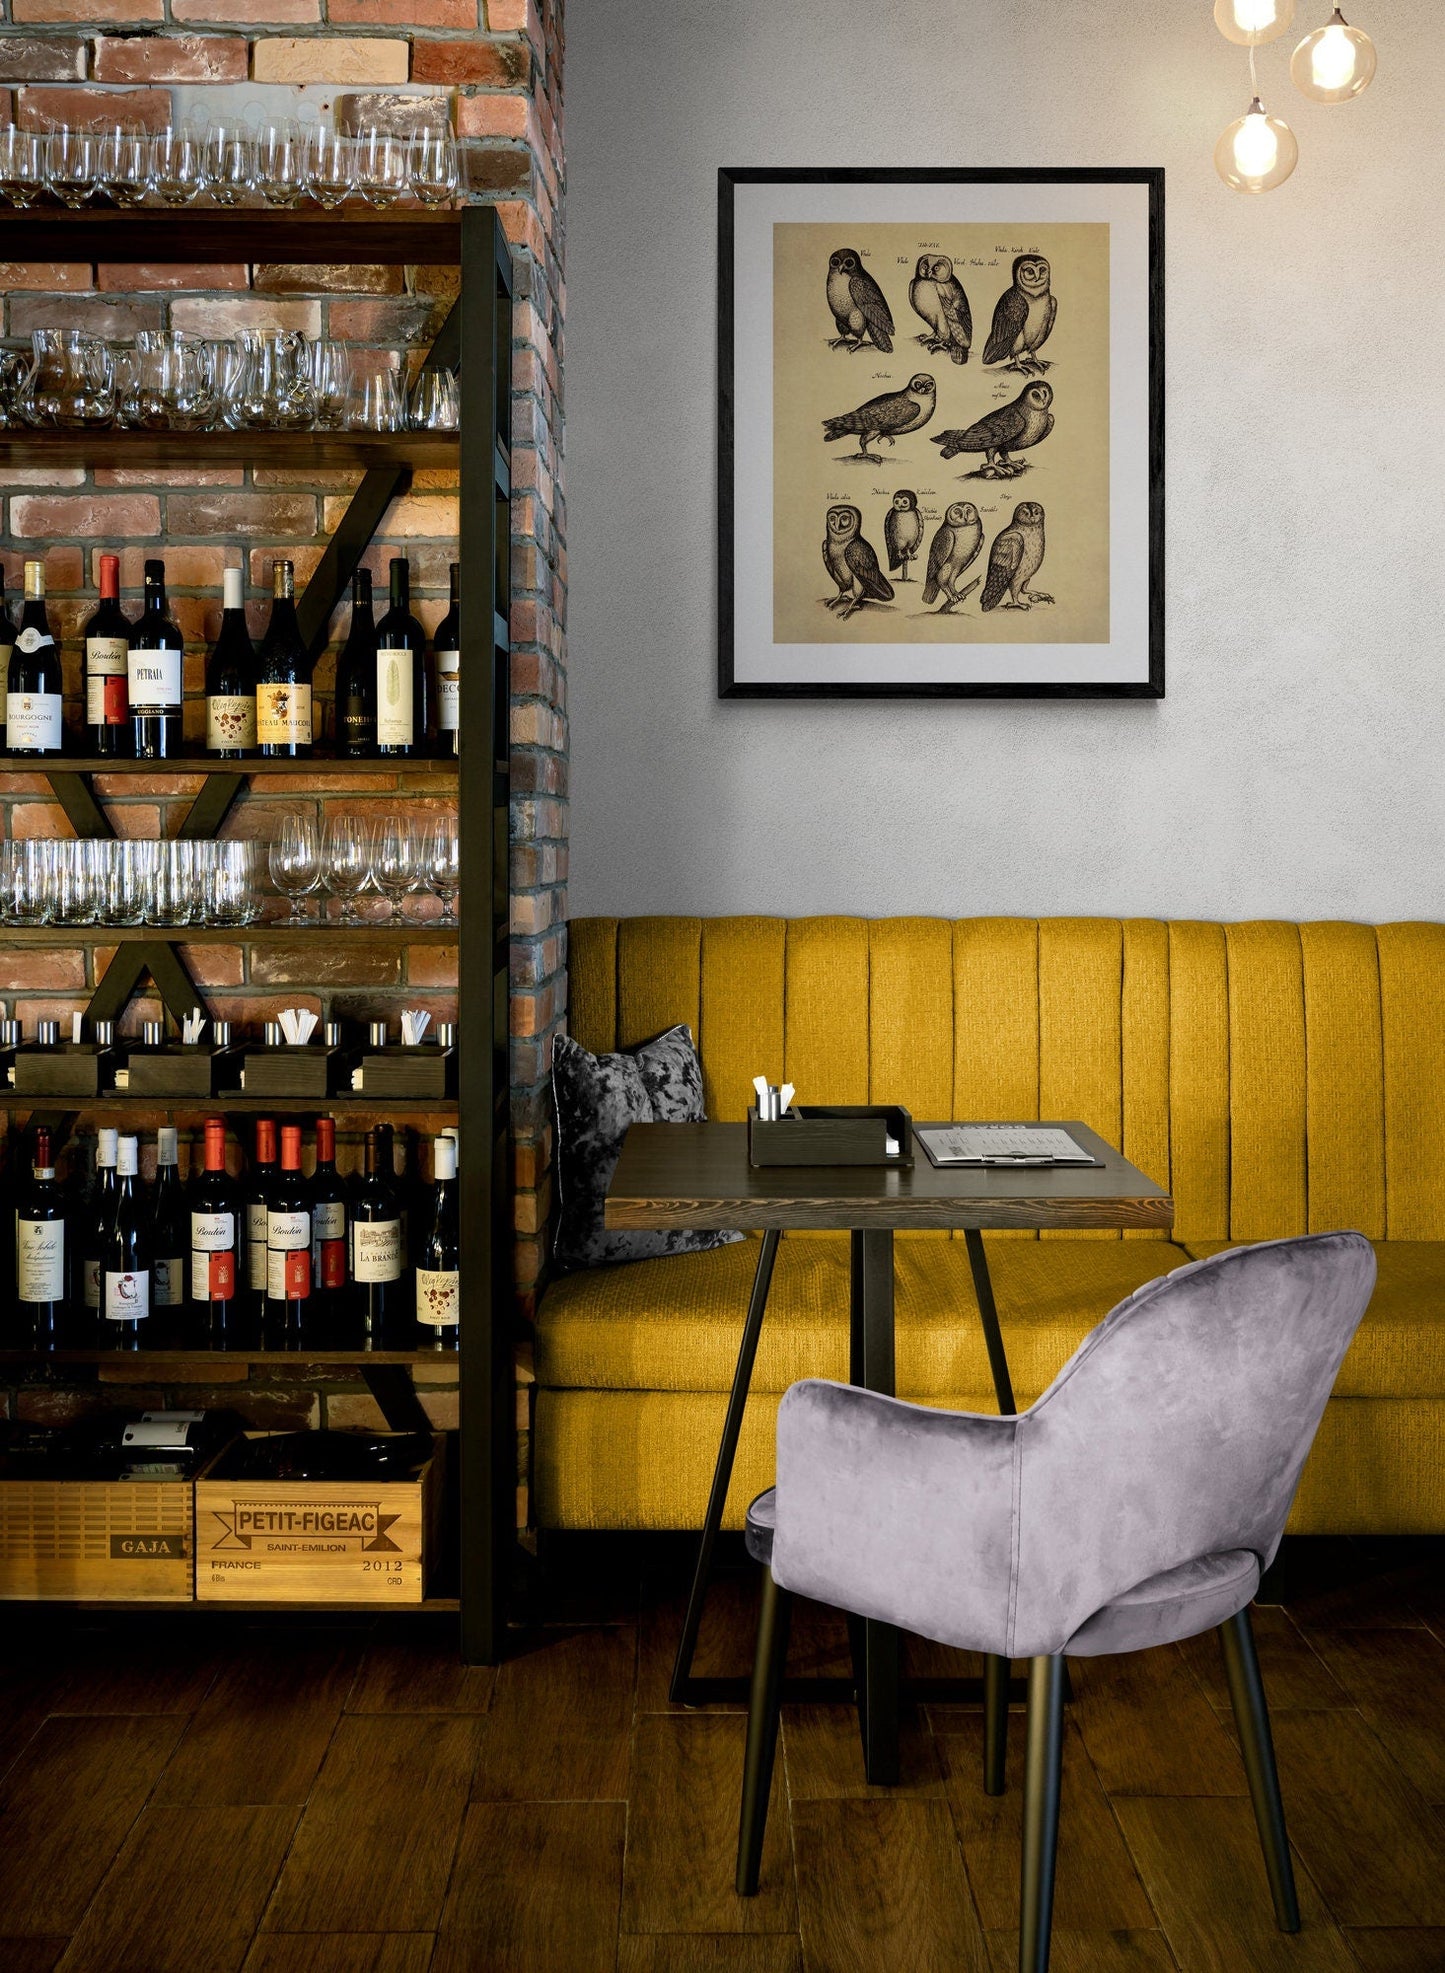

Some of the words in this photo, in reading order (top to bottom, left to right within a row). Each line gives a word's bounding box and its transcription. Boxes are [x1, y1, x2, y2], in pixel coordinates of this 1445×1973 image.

[89, 650, 121, 660] Bordón
[136, 668, 163, 680] PETRAIA
[8, 712, 53, 721] BOURGOGNE
[196, 1226, 226, 1236] Bordón
[272, 1225, 302, 1236] Bordón
[239, 1510, 375, 1532] PETIT-FIGEAC
[121, 1540, 172, 1553] GAJA
[267, 1543, 346, 1552] SAINT-EMILION
[211, 1560, 262, 1570] FRANCE
[363, 1560, 403, 1571] 2012
